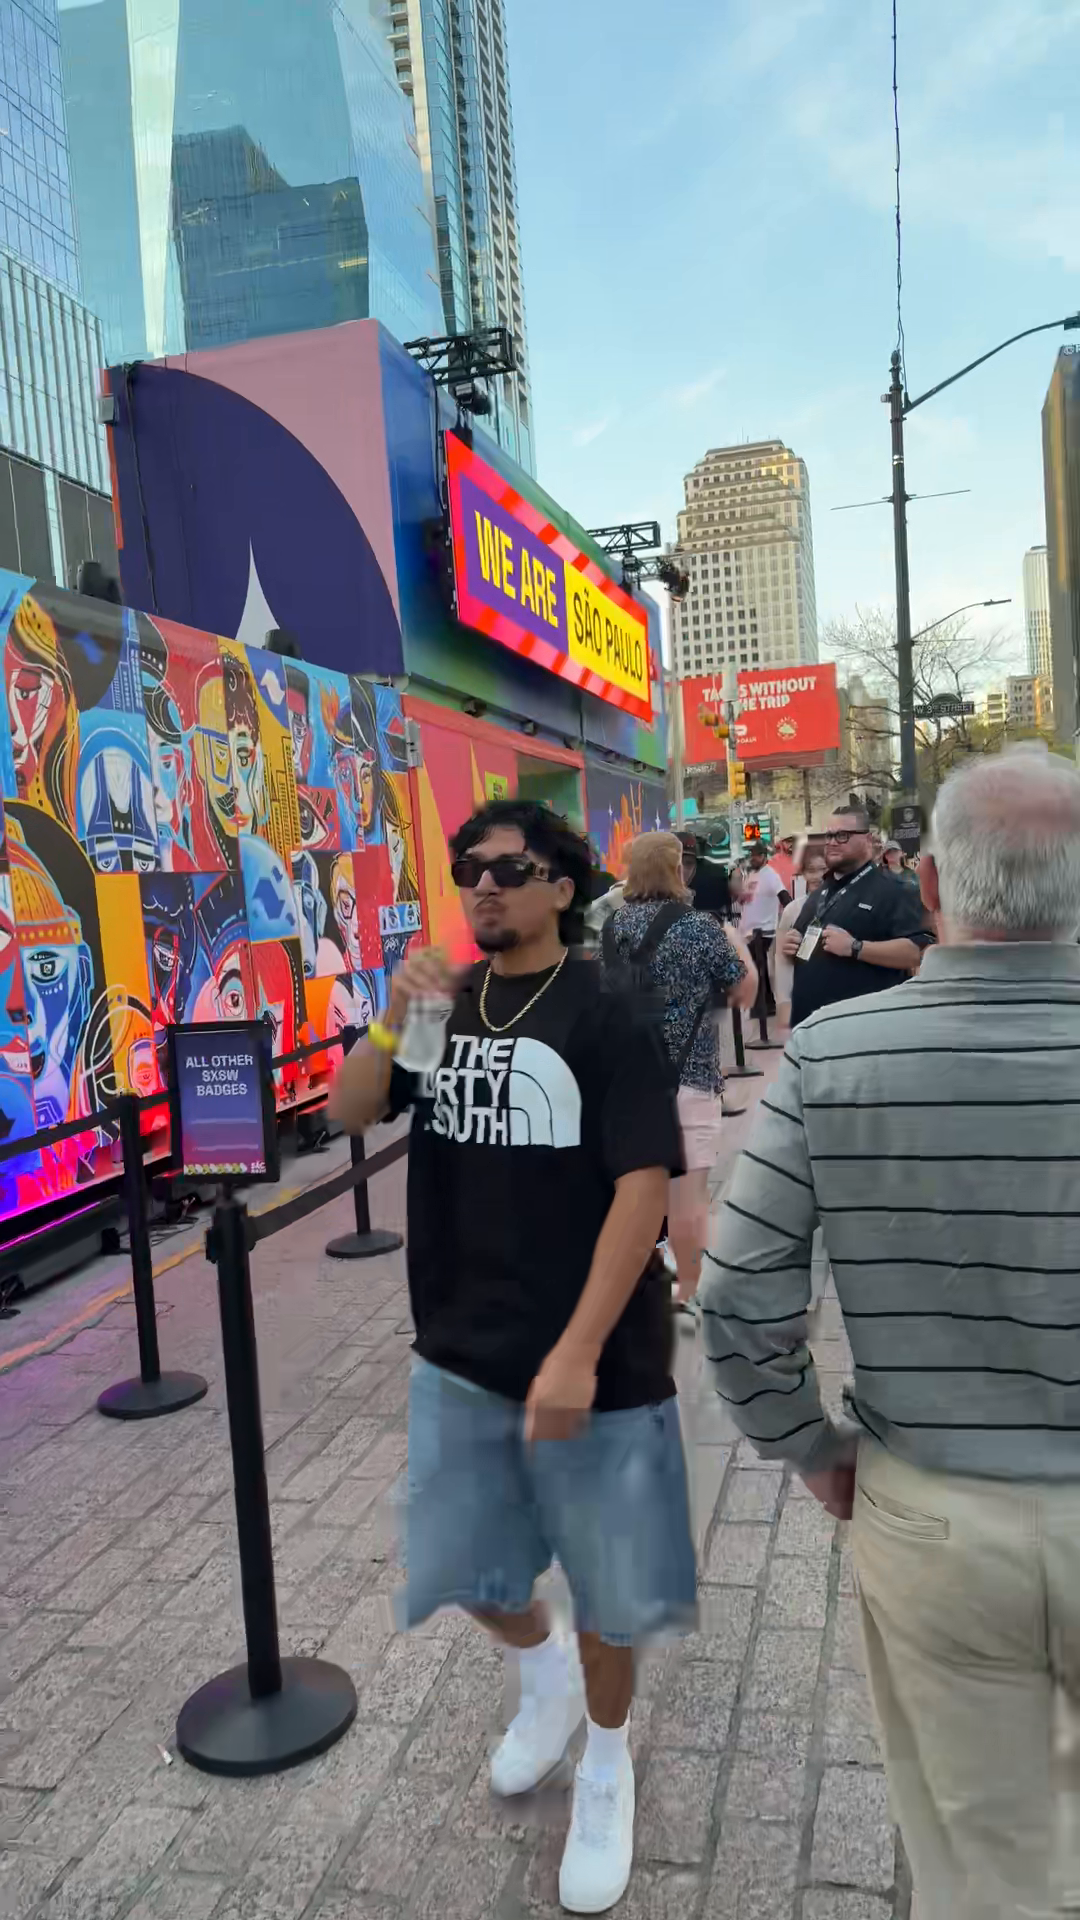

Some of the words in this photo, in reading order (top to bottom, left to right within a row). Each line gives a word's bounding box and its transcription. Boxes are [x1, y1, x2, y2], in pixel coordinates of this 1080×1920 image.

[475, 510, 516, 599] WE
[520, 547, 558, 628] ARE
[573, 587, 602, 653] SÃO
[605, 617, 642, 682] PAULO
[748, 676, 816, 698] WITHOUT
[759, 694, 789, 710] TRIP
[940, 701, 972, 712] STREET
[450, 1034, 515, 1070] THE
[185, 1056, 209, 1069] ALL
[211, 1054, 253, 1067] OTHER
[202, 1069, 239, 1082] SXSW
[196, 1083, 248, 1096] BADGES
